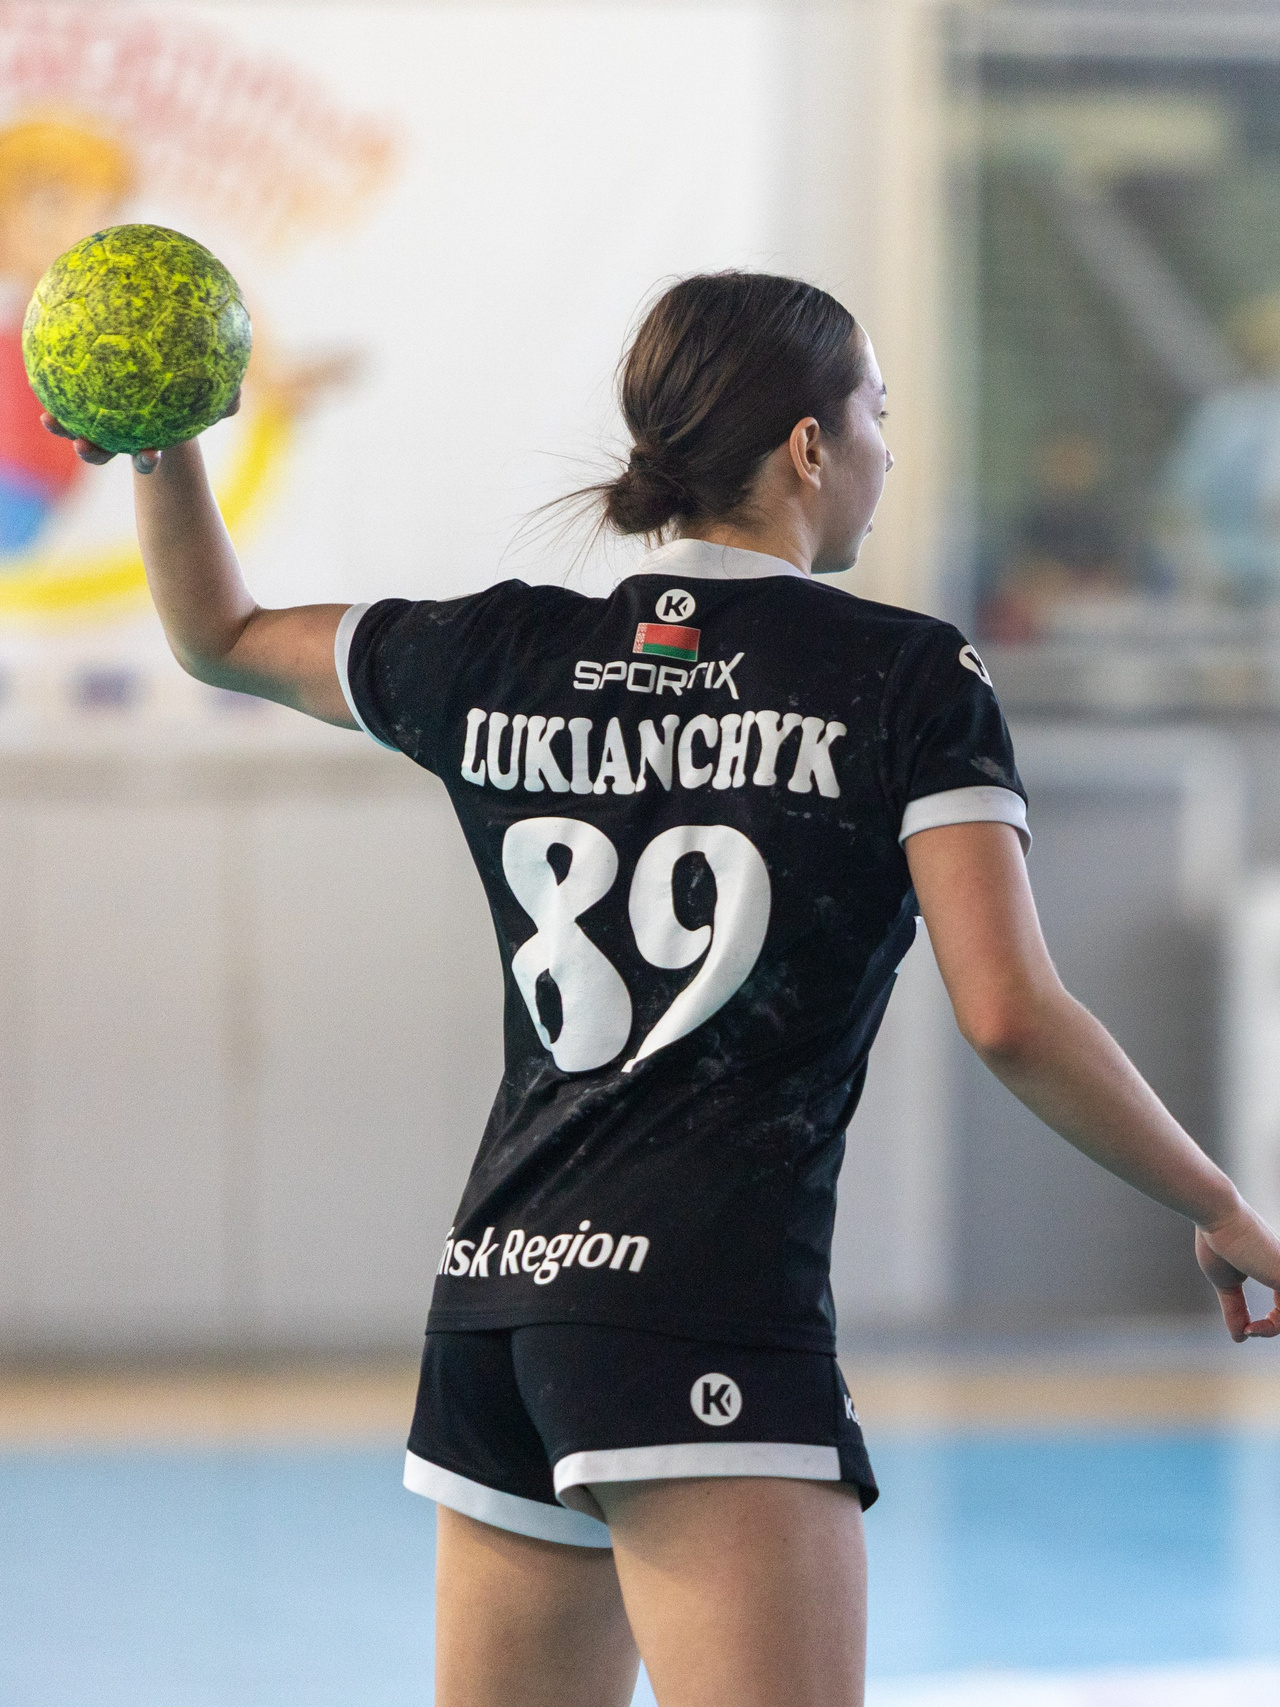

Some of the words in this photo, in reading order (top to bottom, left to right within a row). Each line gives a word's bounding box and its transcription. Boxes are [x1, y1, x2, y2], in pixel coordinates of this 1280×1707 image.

[573, 652, 746, 701] SPORTIX
[460, 707, 848, 799] LUKIANCHYK
[501, 816, 772, 1073] 89
[499, 1219, 651, 1286] Region
